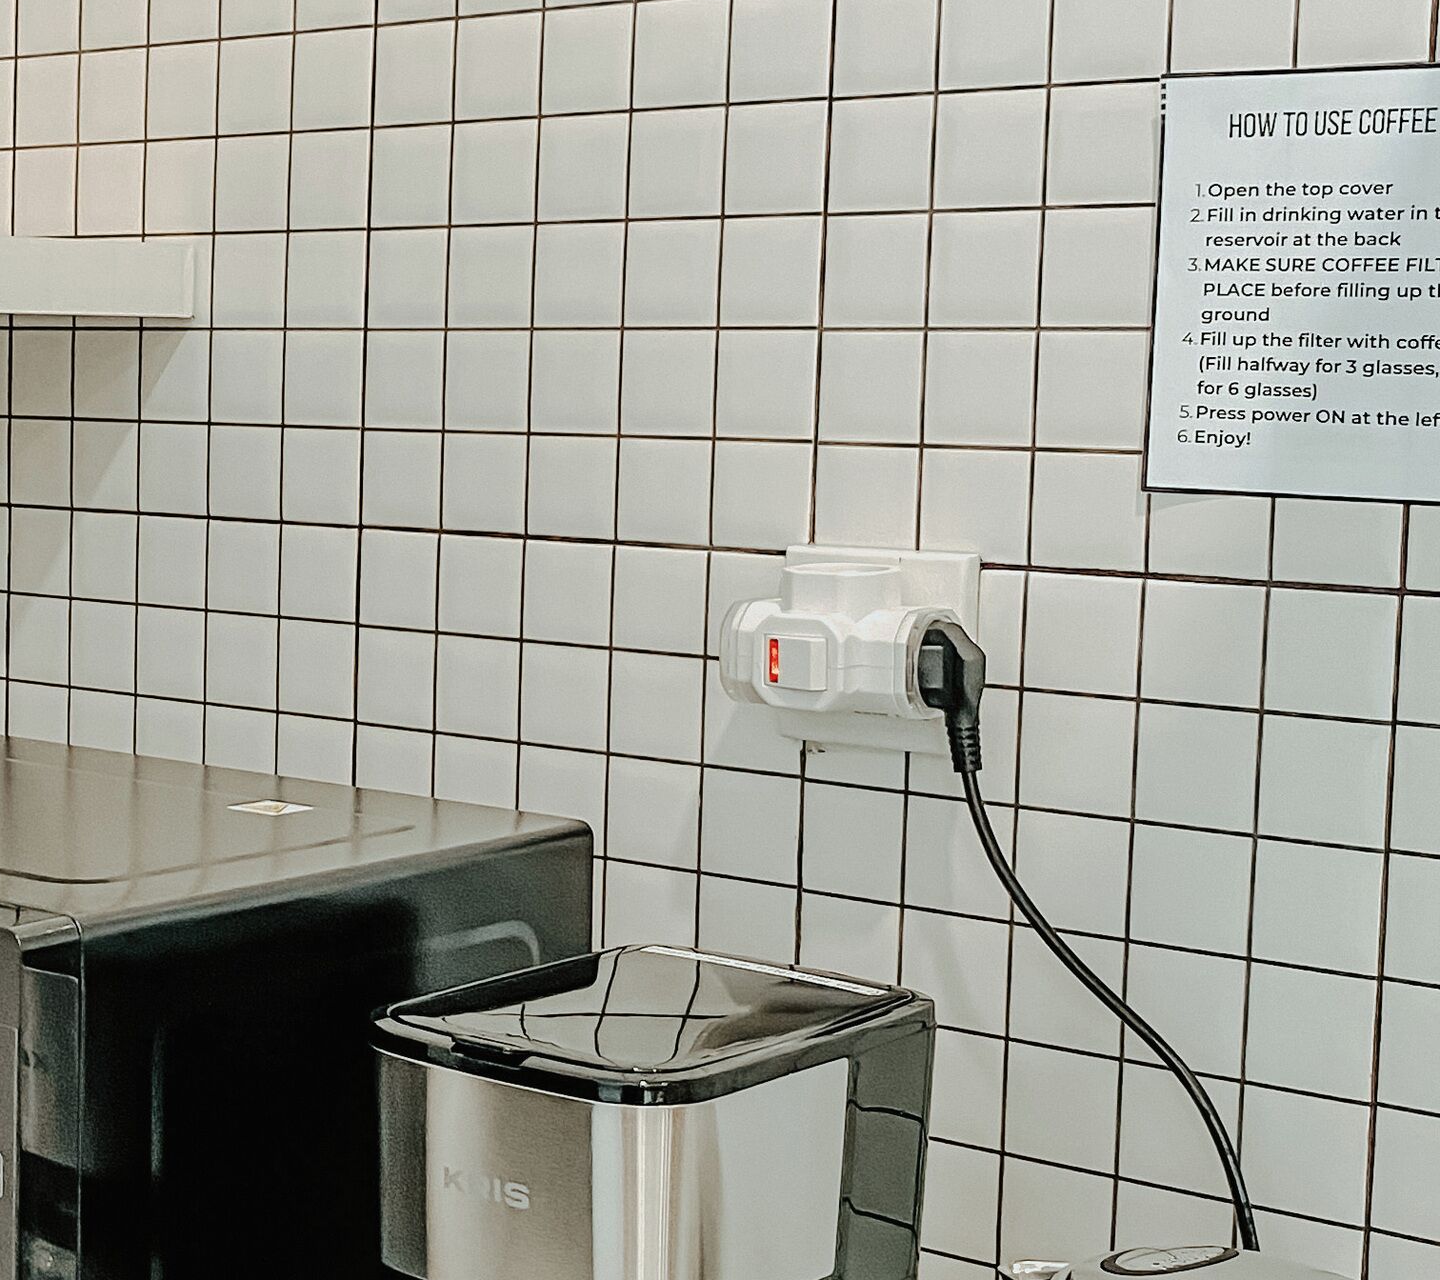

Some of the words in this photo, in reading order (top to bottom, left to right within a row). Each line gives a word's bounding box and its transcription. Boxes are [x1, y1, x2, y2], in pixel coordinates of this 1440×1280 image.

[1228, 112, 1278, 139] HOW
[1282, 111, 1308, 137] TO
[1314, 109, 1354, 136] USE
[1358, 106, 1439, 135] COFFEE
[1207, 183, 1260, 201] Open
[1265, 181, 1297, 197] the
[1301, 182, 1334, 200] top
[1338, 183, 1394, 196] cover
[1207, 206, 1234, 222] Fill
[1239, 206, 1257, 222] in
[1262, 206, 1342, 225] drinking
[1347, 207, 1406, 221] water
[1410, 204, 1428, 221] in
[1205, 231, 1289, 247] reservoir
[1292, 233, 1312, 247] at
[1317, 231, 1349, 247] the
[1353, 230, 1402, 247] back
[1204, 257, 1261, 272] MAKE
[1264, 257, 1317, 273] SURE
[1321, 257, 1400, 273] COFFEE
[1203, 282, 1266, 297] PLACE
[1270, 282, 1332, 298] before
[1337, 282, 1391, 302] filling
[1397, 286, 1423, 302] up
[1201, 306, 1270, 325] ground
[1200, 330, 1227, 347] Fill
[1232, 335, 1257, 351] up
[1261, 331, 1294, 347] the
[1298, 331, 1343, 349] filter
[1346, 333, 1390, 350] with
[1199, 355, 1232, 374] (Fill
[1237, 356, 1311, 376] halfway
[1315, 357, 1342, 374] for
[1345, 359, 1357, 374] 3
[1362, 359, 1440, 379] glasses,
[1196, 379, 1224, 396] for
[1228, 381, 1240, 396] 6
[1244, 381, 1318, 402] glasses)
[1196, 405, 1246, 421] Press
[1251, 409, 1312, 425] power
[1315, 409, 1346, 424] ON
[1351, 411, 1371, 425] at
[1376, 410, 1410, 427] the
[1194, 429, 1251, 449] Enjoy!
